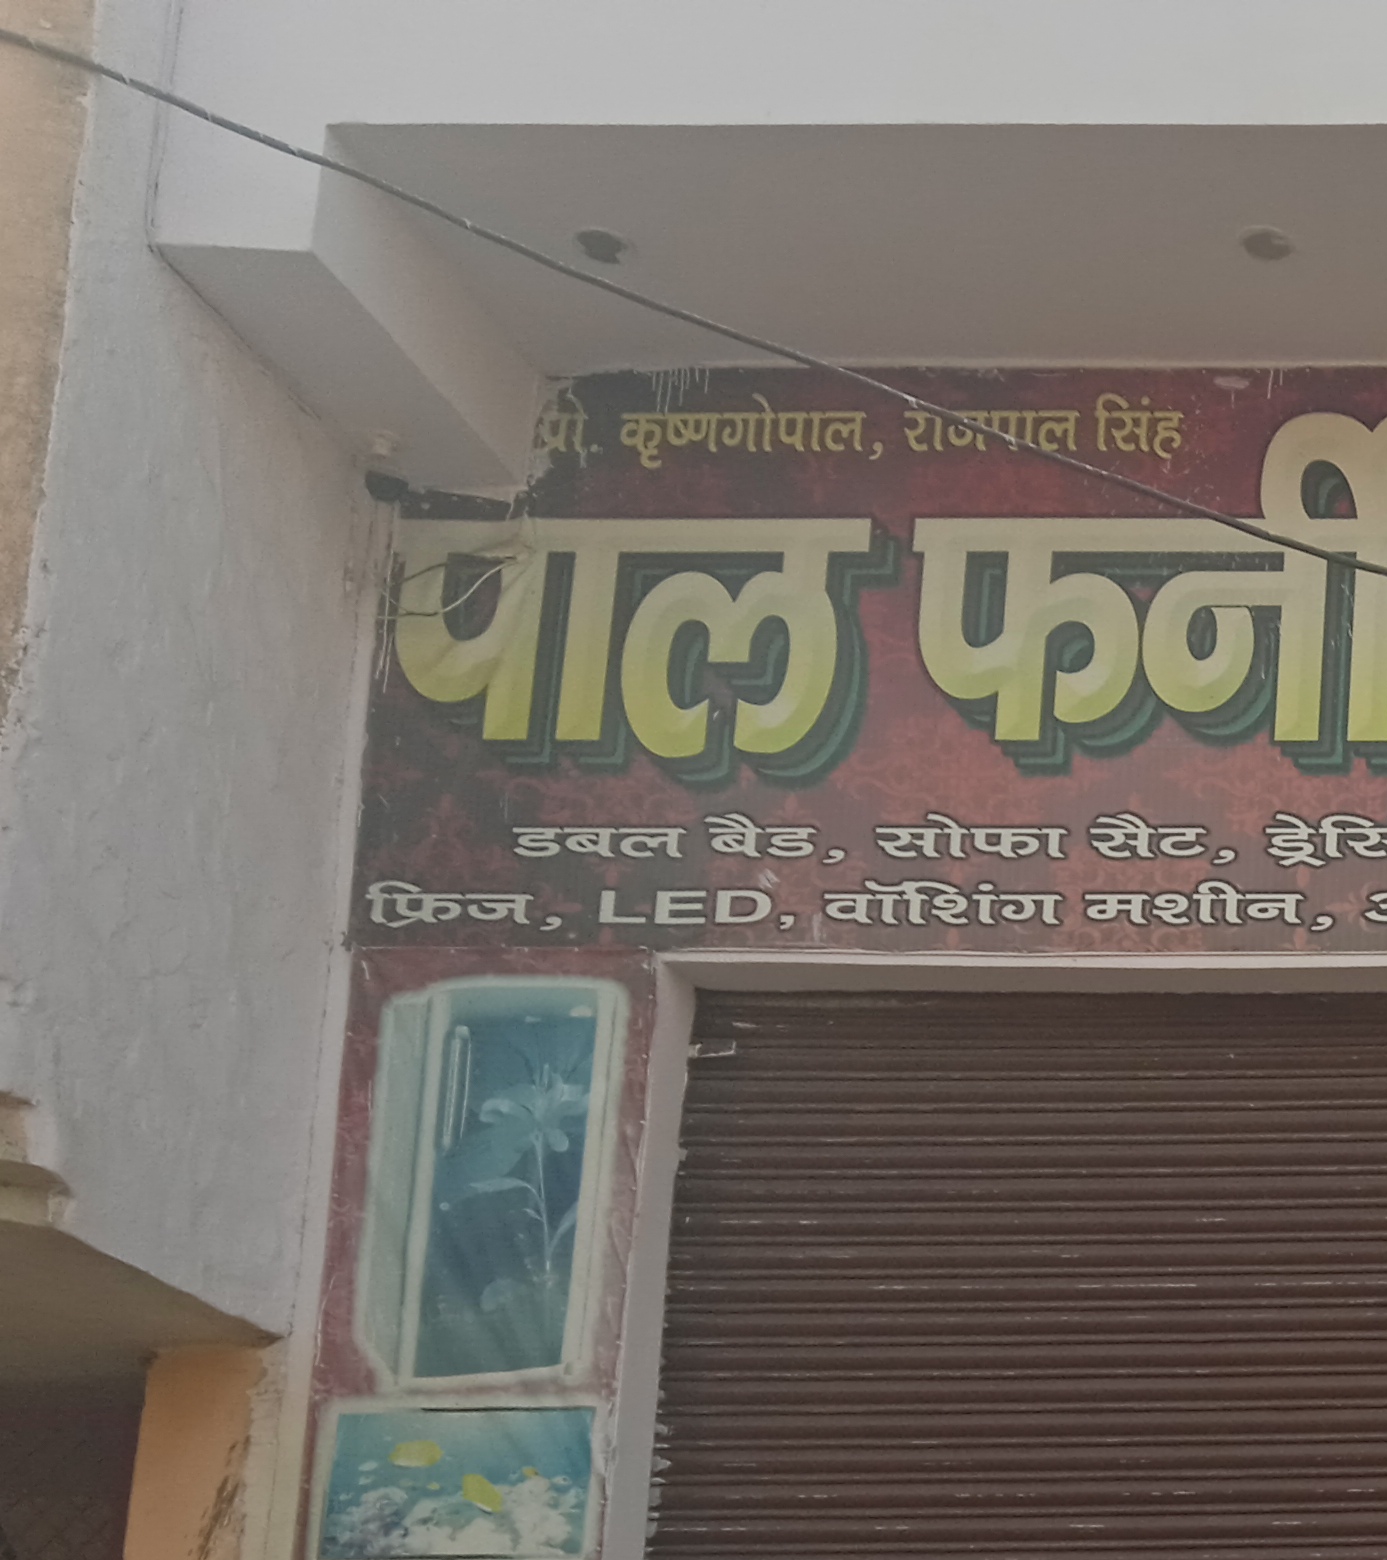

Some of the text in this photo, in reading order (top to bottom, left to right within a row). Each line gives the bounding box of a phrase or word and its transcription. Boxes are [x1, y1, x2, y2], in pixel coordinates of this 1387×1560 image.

[620, 393, 884, 469] कृष्णगोपाल,
[903, 409, 1081, 452] राजपाल
[1095, 393, 1185, 460] सिंह
[394, 517, 873, 759] पाल
[512, 826, 687, 859] डबल
[704, 812, 845, 864] बैड,
[875, 813, 1067, 859] सोफा
[1090, 812, 1236, 864] सैट,
[365, 880, 563, 931] फ्रिज,
[598, 889, 796, 931] LED,
[823, 880, 1064, 925] वॉशिंग
[1084, 880, 1335, 931] मशीन,
